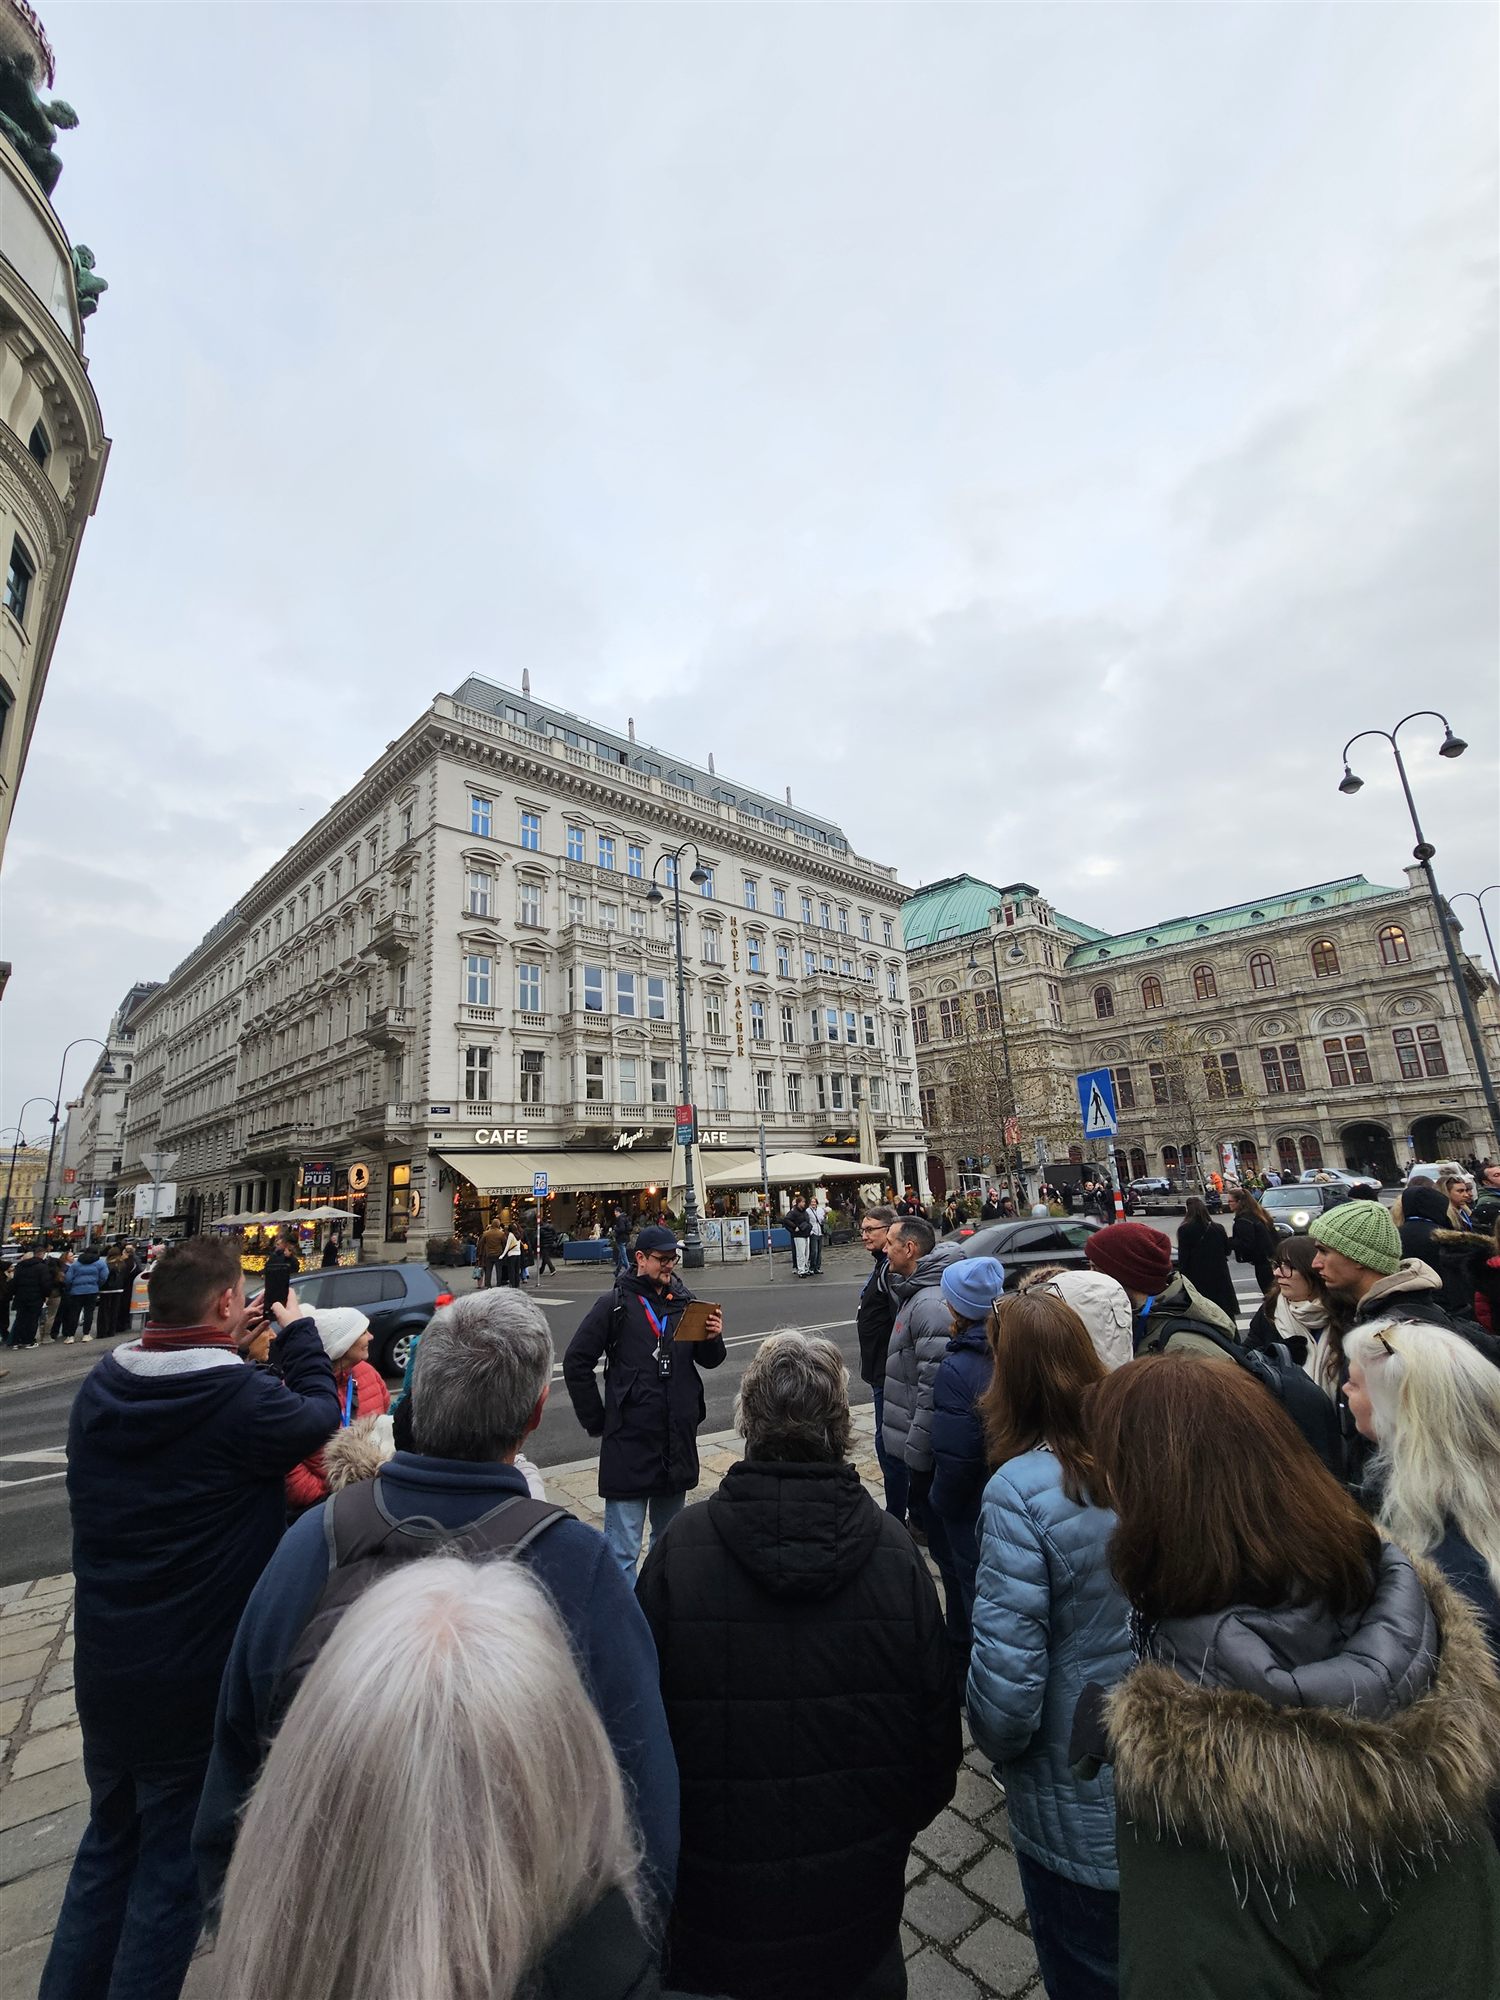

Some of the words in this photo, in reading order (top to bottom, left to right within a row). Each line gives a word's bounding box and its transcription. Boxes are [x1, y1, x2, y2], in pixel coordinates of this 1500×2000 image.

[730, 916, 740, 973] HOTEL
[734, 986, 744, 1057] SACHER
[475, 1129, 529, 1144] CAFE
[613, 1128, 643, 1151] Mozart
[304, 1174, 331, 1185] PUB
